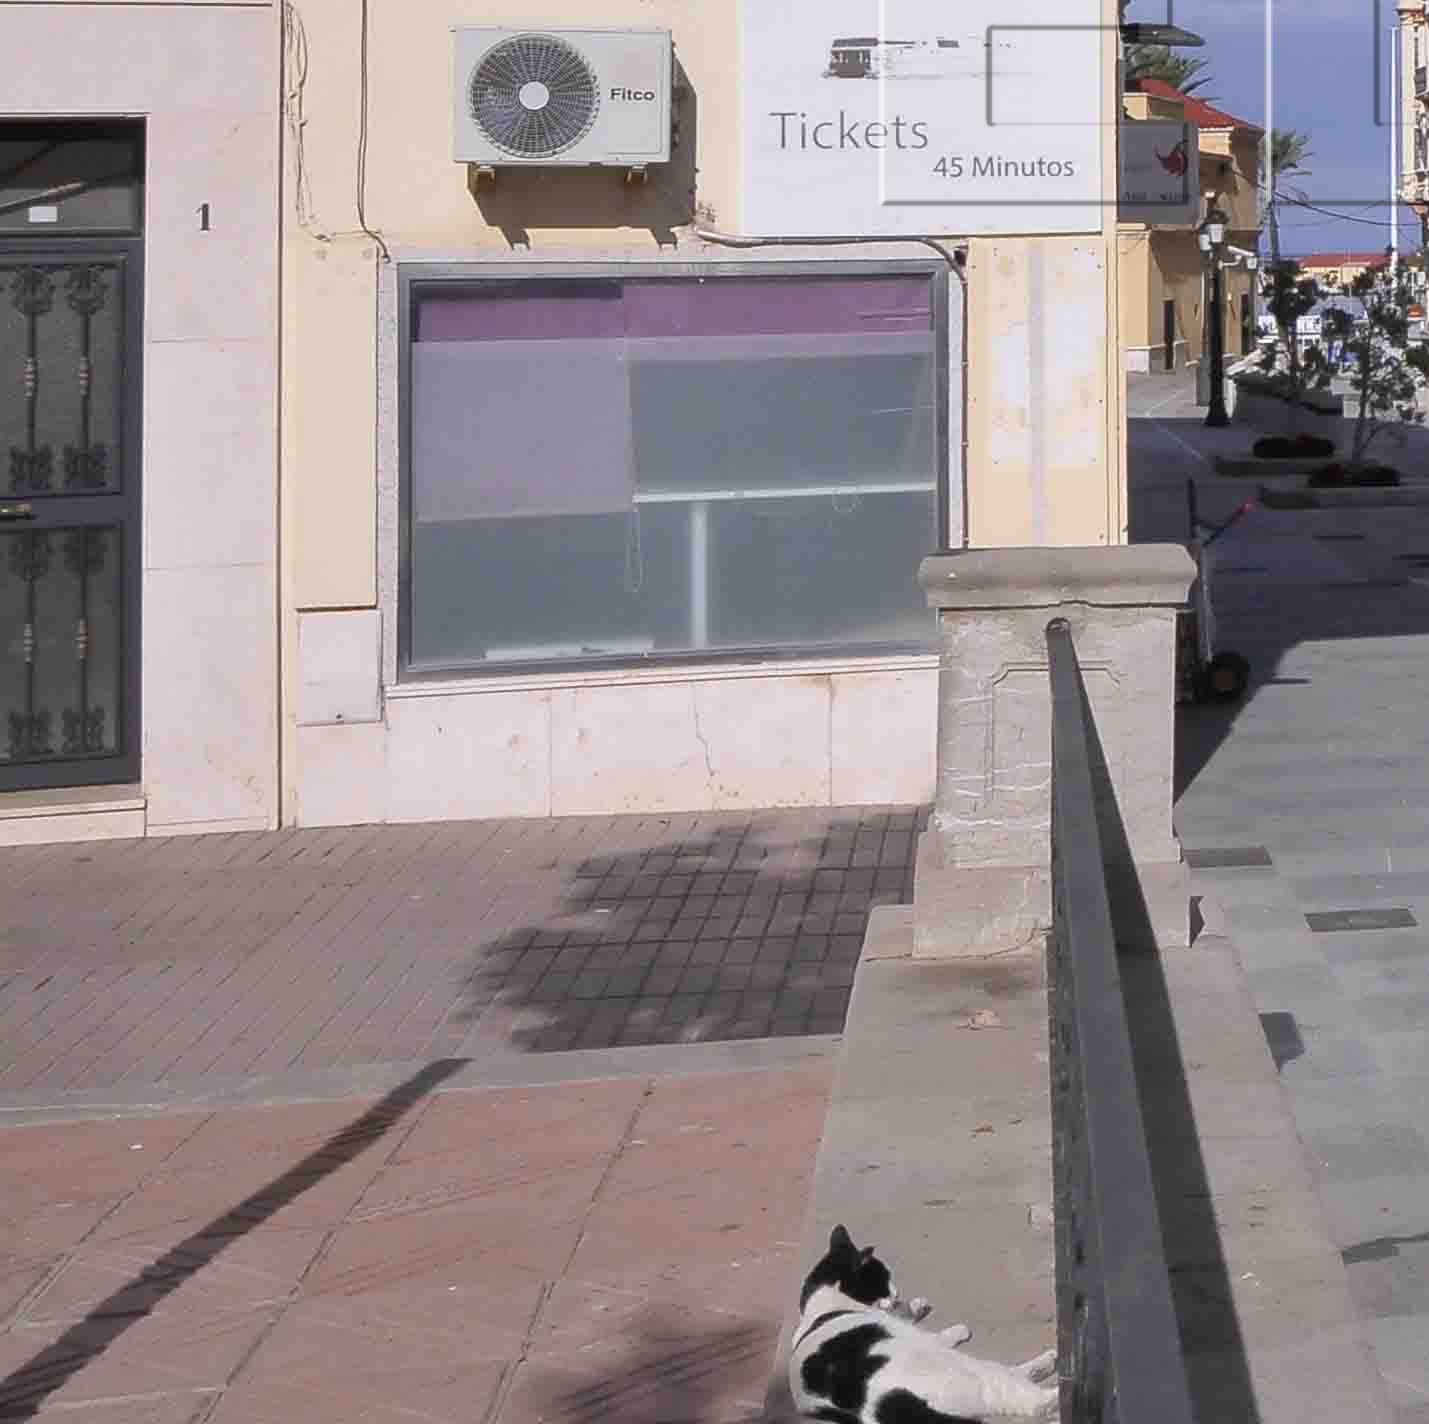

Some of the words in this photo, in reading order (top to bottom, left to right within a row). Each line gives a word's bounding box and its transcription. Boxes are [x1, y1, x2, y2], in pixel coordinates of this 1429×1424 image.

[768, 110, 929, 149] Tickets
[932, 156, 964, 178] 45
[971, 155, 1075, 178] Minutos
